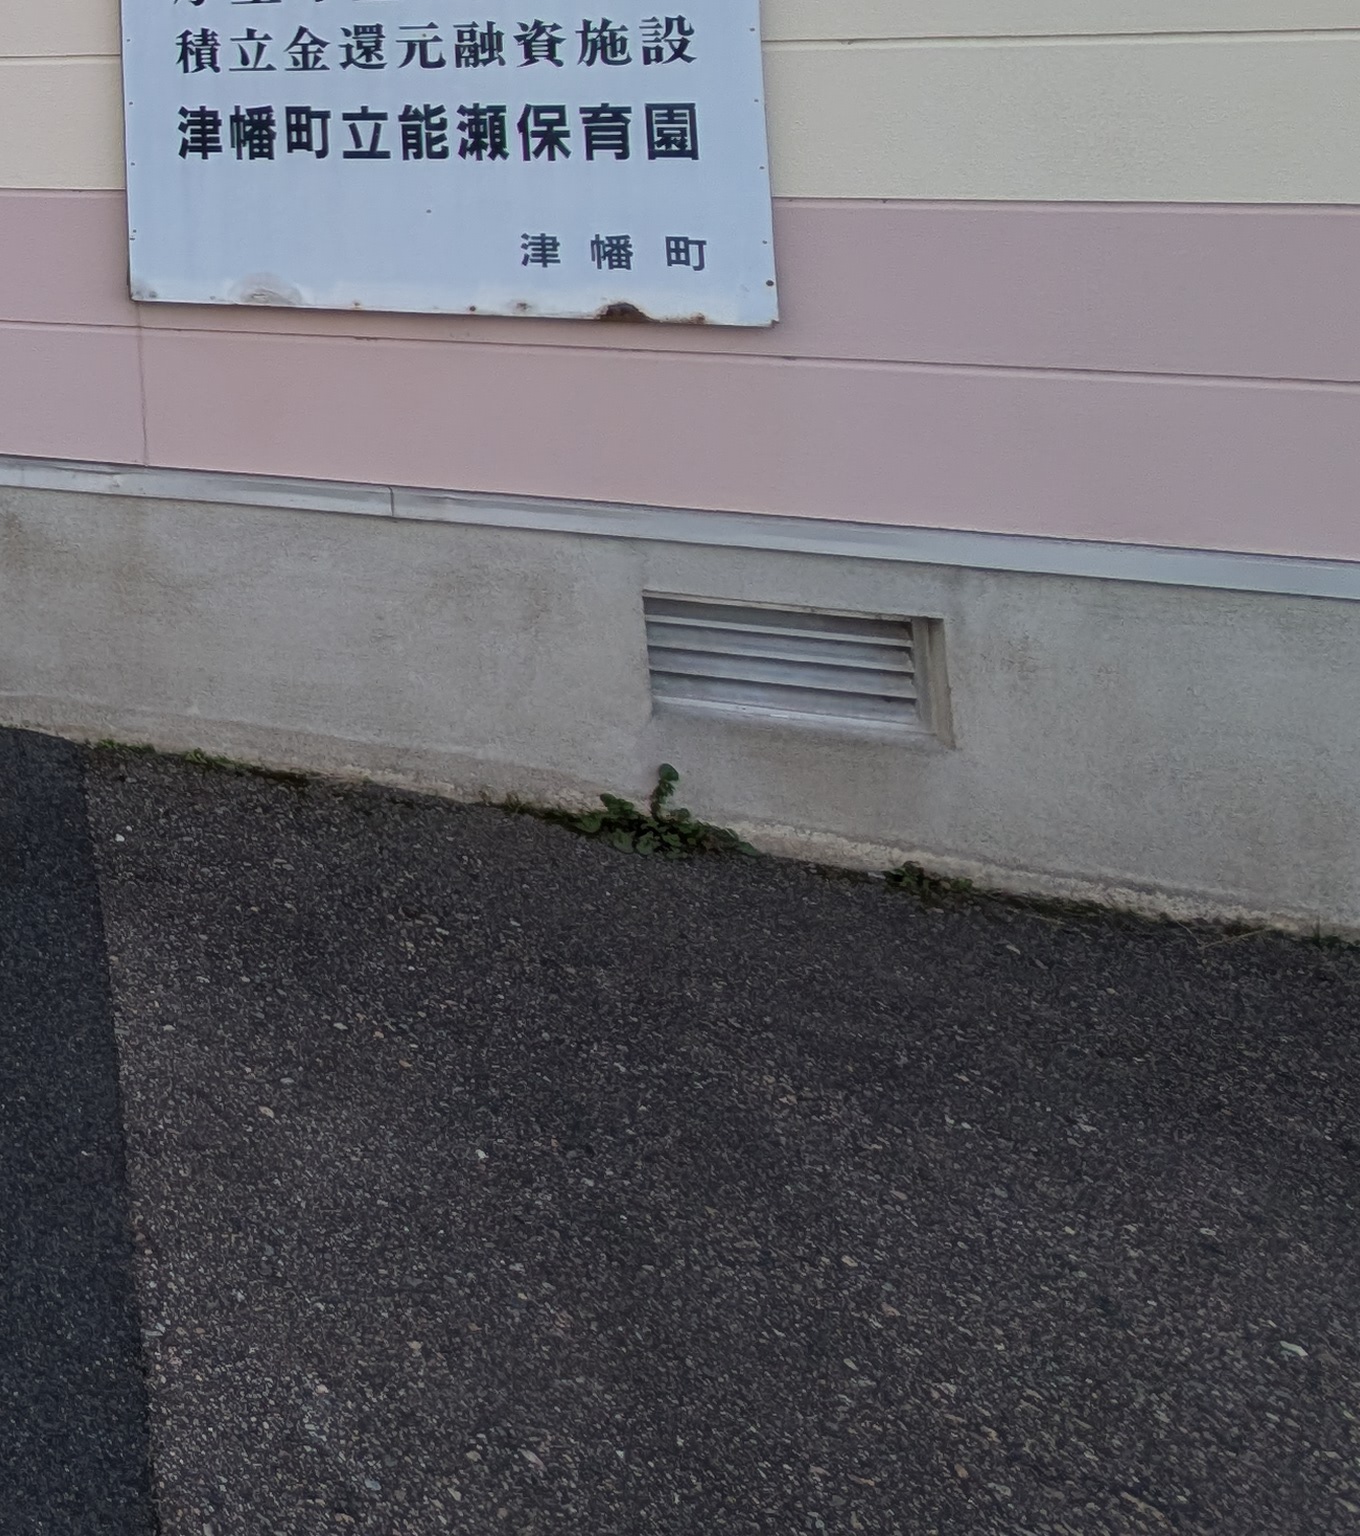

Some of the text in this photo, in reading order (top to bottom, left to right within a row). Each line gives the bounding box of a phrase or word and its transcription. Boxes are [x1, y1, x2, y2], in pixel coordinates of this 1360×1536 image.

[175, 15, 696, 75] 積立金還元融資施設
[177, 102, 700, 162] 津幡町立能瀬保育園
[520, 232, 707, 272] 津幡町
